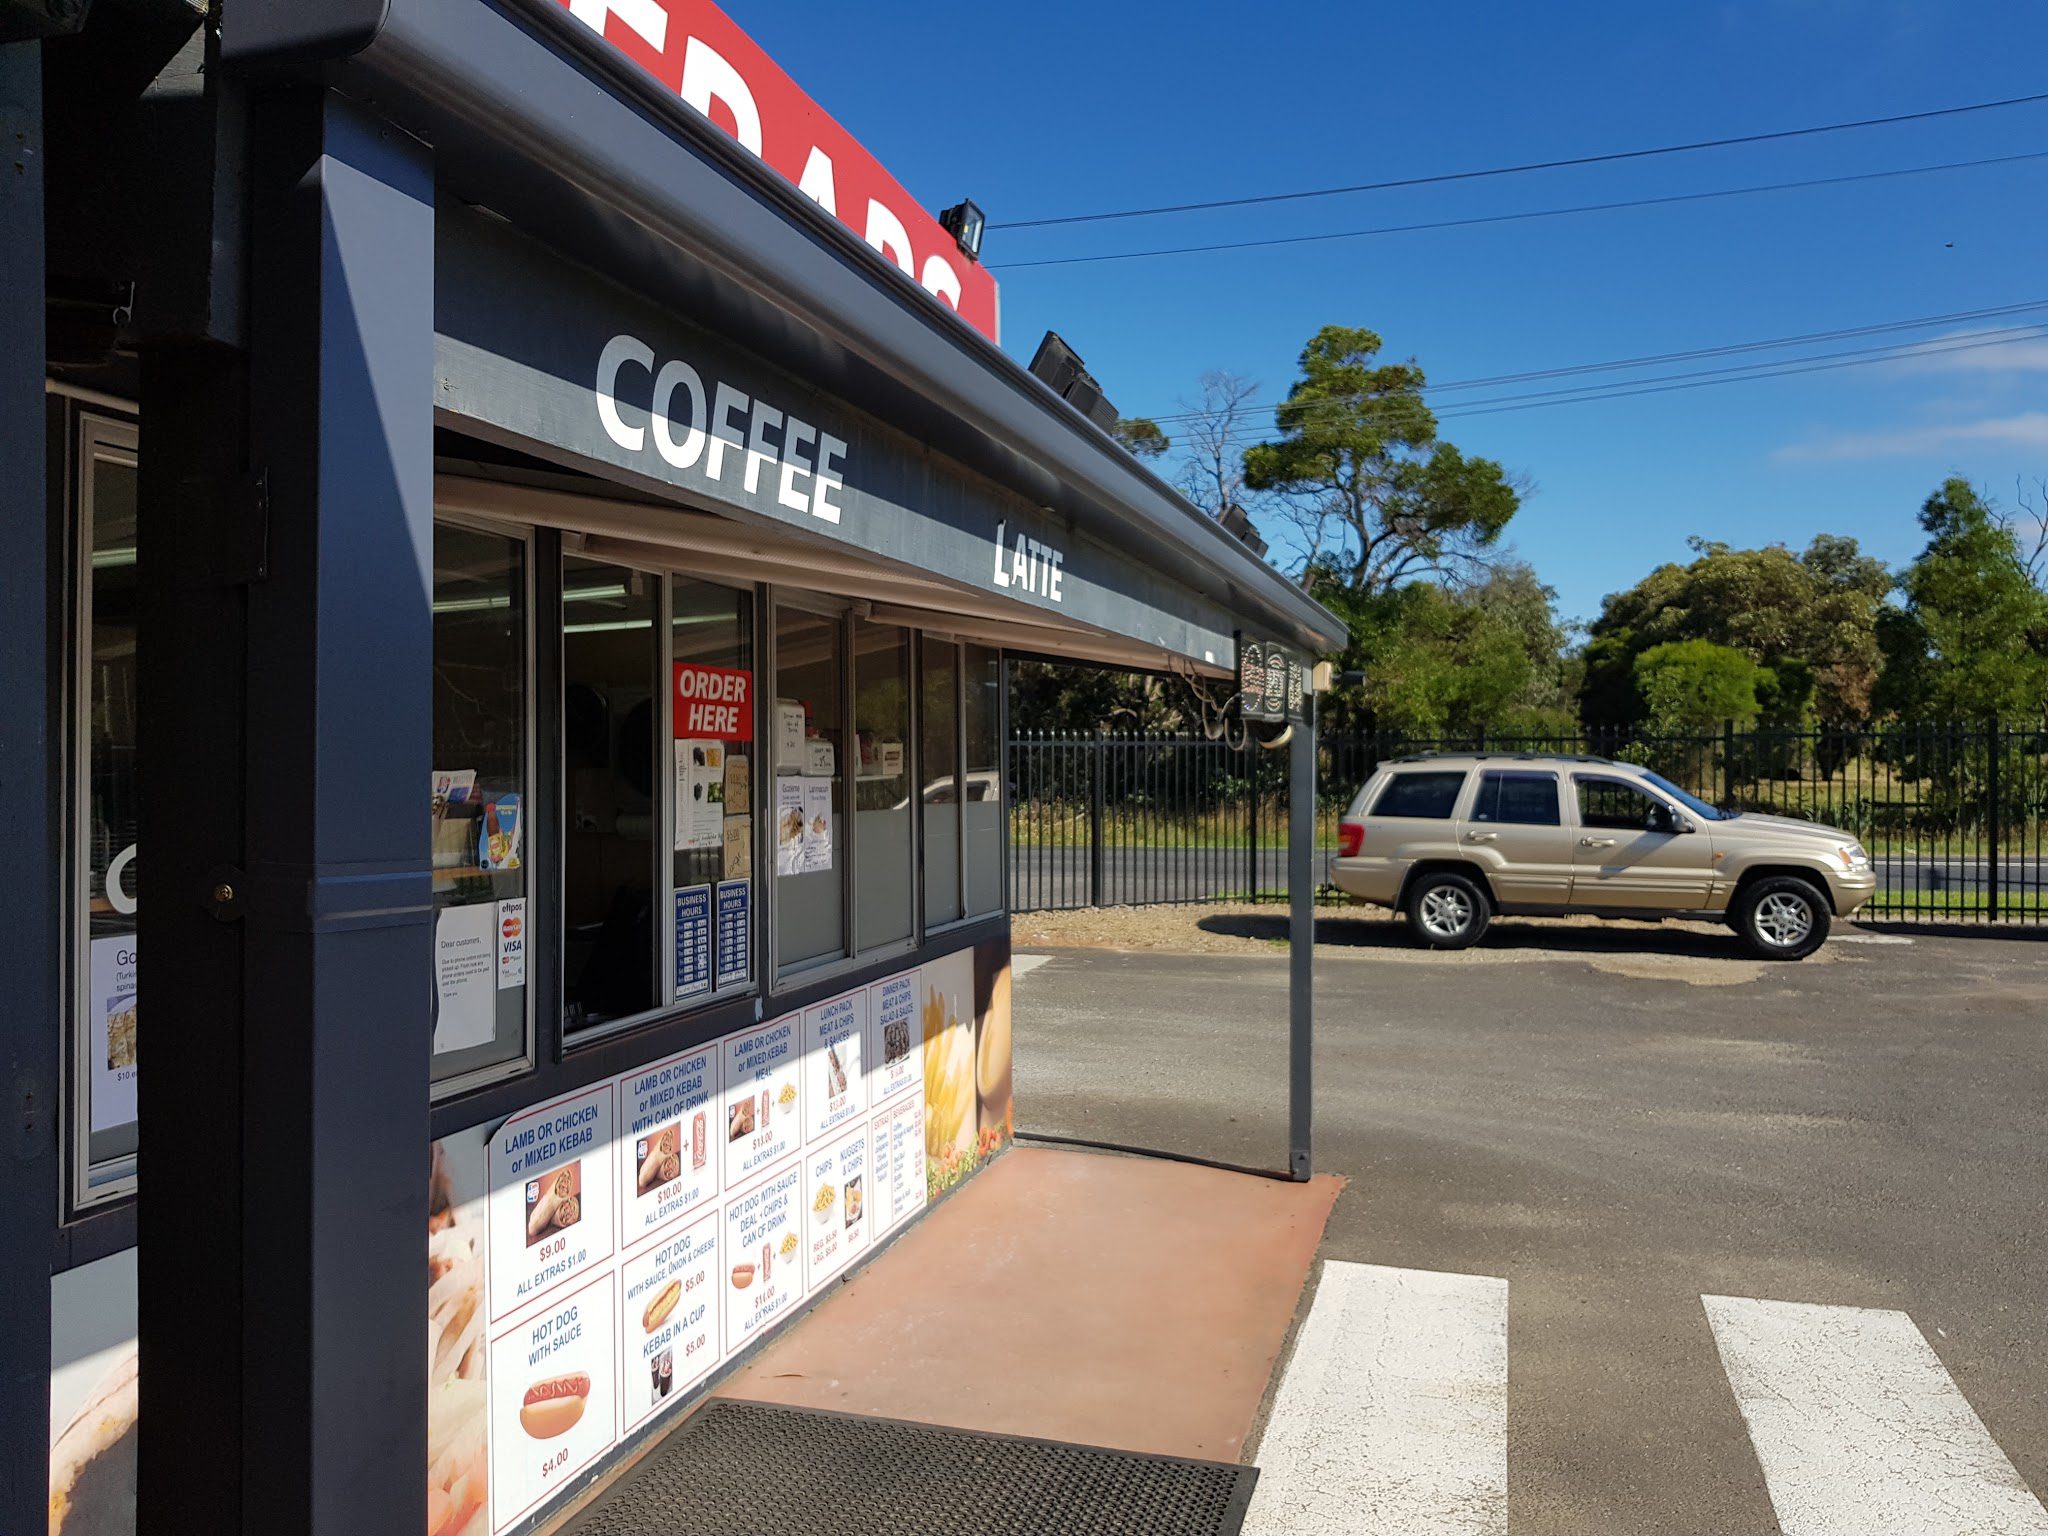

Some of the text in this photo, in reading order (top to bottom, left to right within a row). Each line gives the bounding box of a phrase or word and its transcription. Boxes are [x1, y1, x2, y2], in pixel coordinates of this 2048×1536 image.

[596, 335, 848, 525] COFFEE
[993, 520, 1063, 602] LATTE
[680, 669, 746, 703] ORDER
[688, 703, 739, 733] HERE
[677, 894, 707, 906] BUSINESS
[720, 888, 746, 899] BUSINESS
[724, 899, 742, 909] HOURS
[681, 906, 703, 917] HOURS
[504, 940, 522, 952] VISA
[819, 1013, 854, 1035] MEAT & CHIPS
[821, 999, 853, 1020] LUNCH PACK
[734, 1024, 791, 1057] LAMB OR CHICKEN
[738, 1042, 788, 1072] or MIXED KEBAB
[635, 1055, 706, 1095] LAMB OR CHICKEN
[756, 1065, 772, 1082] MEAL
[639, 1075, 702, 1112] or MIXED KEBAB
[632, 1090, 709, 1135] WITH CAN OF DRINK
[505, 1104, 598, 1154] LAMB OR CHICKEN
[512, 1127, 592, 1173] or MIXED KEBAB
[743, 1141, 785, 1171] ALL EXTRAS $1.00
[840, 1138, 864, 1161] NUGGETS
[848, 1155, 862, 1172] CHIPS
[816, 1158, 832, 1178] CHIPS
[645, 1188, 699, 1226] ALL EXTRAS $1.00
[657, 1181, 682, 1204] $10.00
[729, 1172, 797, 1222] HOT DOG WITH SAUCE
[740, 1215, 757, 1233] DEAL
[764, 1197, 783, 1217] CHIPS
[743, 1212, 787, 1248] CAN OF DRINK
[540, 1237, 566, 1262] $9.00
[655, 1235, 691, 1267] HOT DOG
[517, 1249, 586, 1296] ALL EXTRAS $1.00
[628, 1282, 643, 1300] WITH
[645, 1268, 667, 1288] SAUCE,
[669, 1257, 687, 1275] ONION
[694, 1238, 715, 1259] CHEESE
[685, 1271, 705, 1292] $5.00
[532, 1306, 578, 1345] HOT DOG
[643, 1304, 705, 1358] KEBAB IN A CUP
[744, 1319, 754, 1332] ALL
[529, 1323, 582, 1366] WITH SAUCE
[686, 1334, 705, 1357] $5.00
[542, 1448, 569, 1477] $4.00
